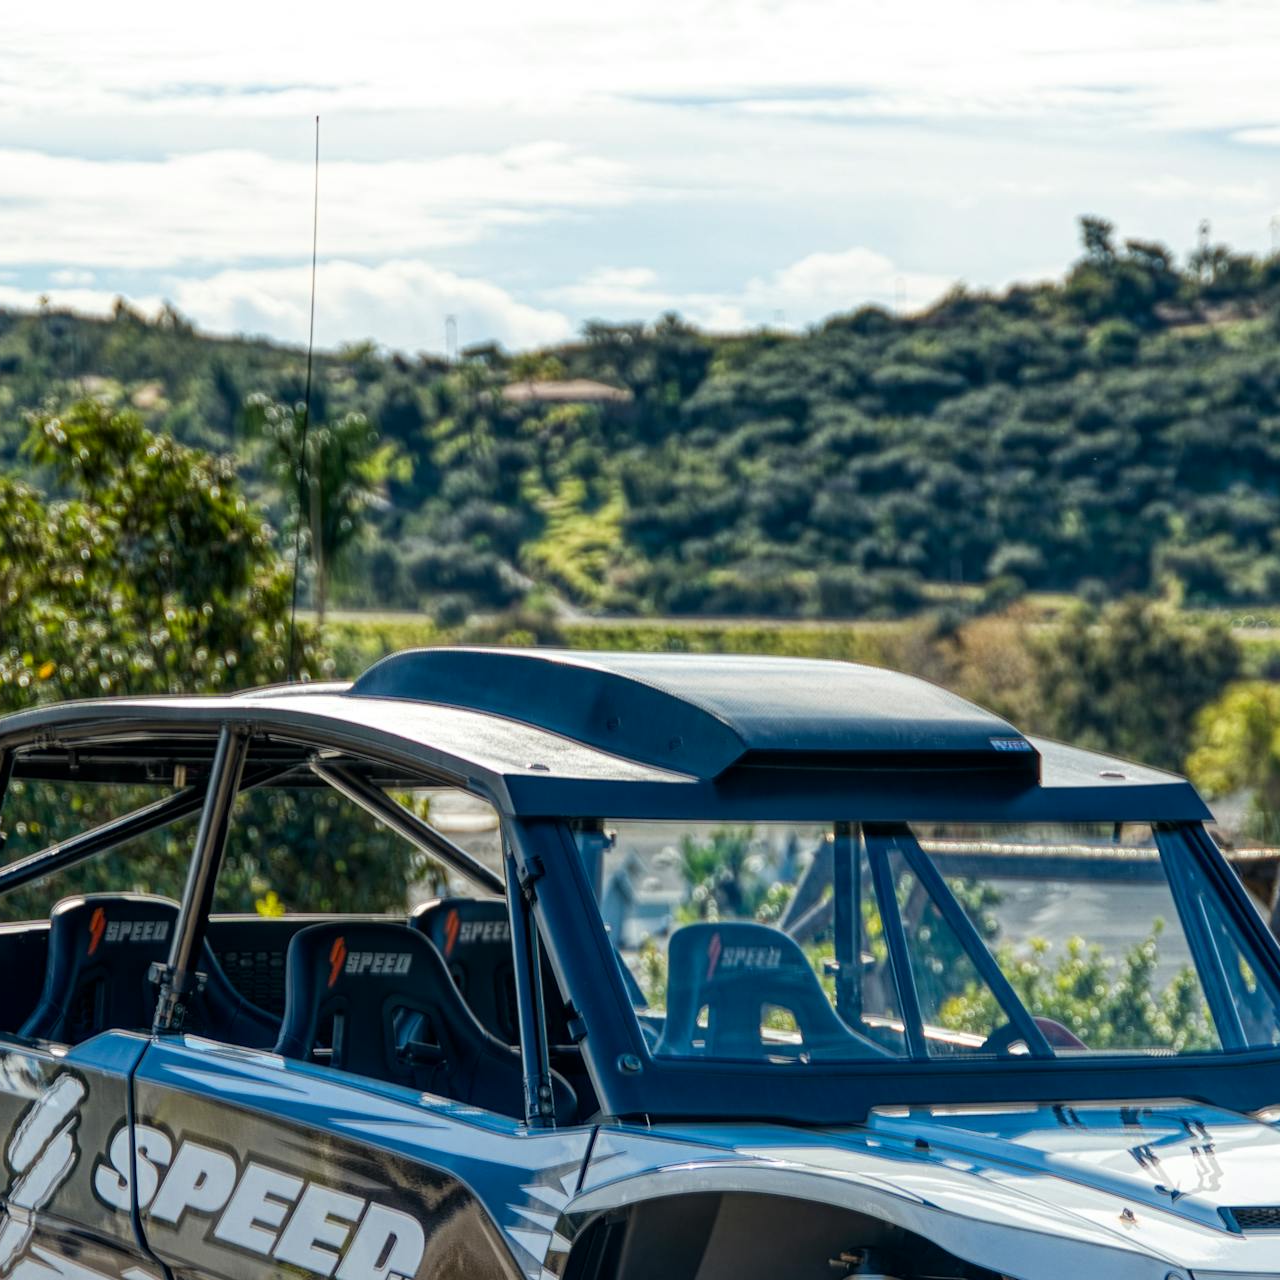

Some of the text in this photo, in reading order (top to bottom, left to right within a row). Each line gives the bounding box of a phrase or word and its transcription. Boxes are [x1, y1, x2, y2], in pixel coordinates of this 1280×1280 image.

[105, 920, 169, 941] SPEED
[345, 951, 413, 974] SPEED
[721, 946, 781, 968] SPEED
